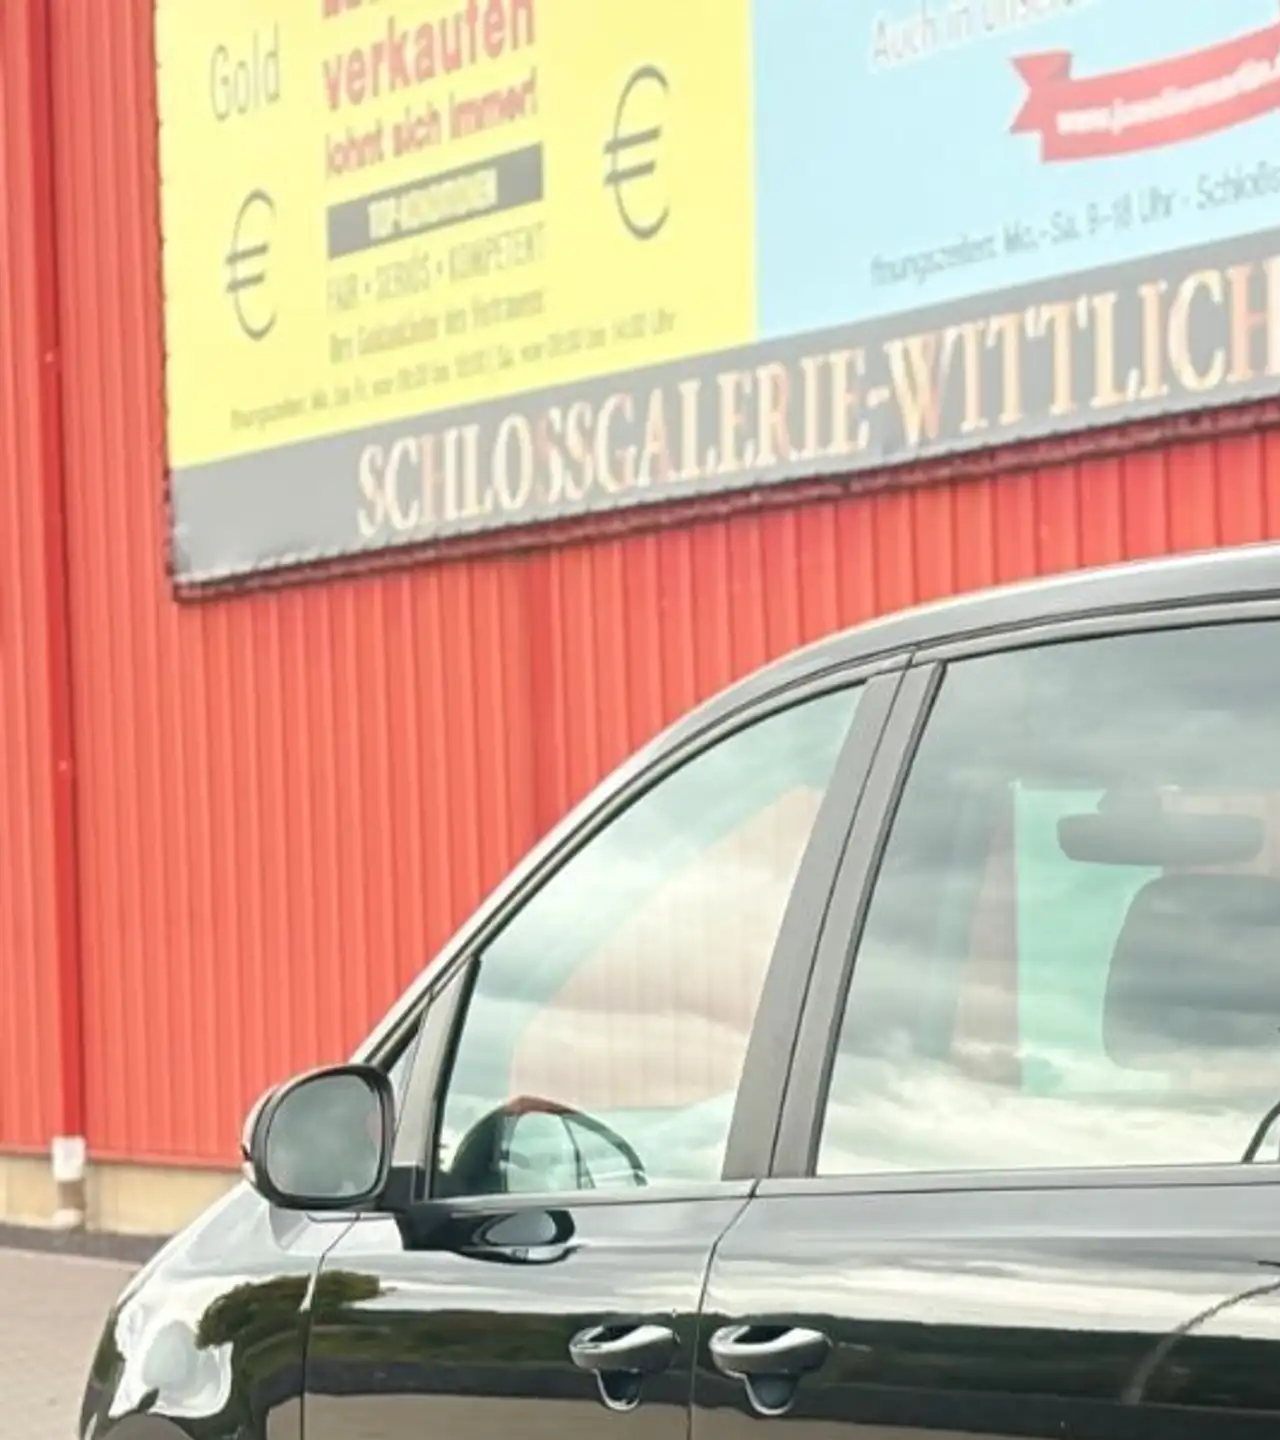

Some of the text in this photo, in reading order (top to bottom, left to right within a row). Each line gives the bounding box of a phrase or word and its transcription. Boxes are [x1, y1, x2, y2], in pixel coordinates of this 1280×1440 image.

[210, 18, 281, 122] Gold
[321, 0, 536, 112] verkaufen
[392, 100, 442, 158] sich
